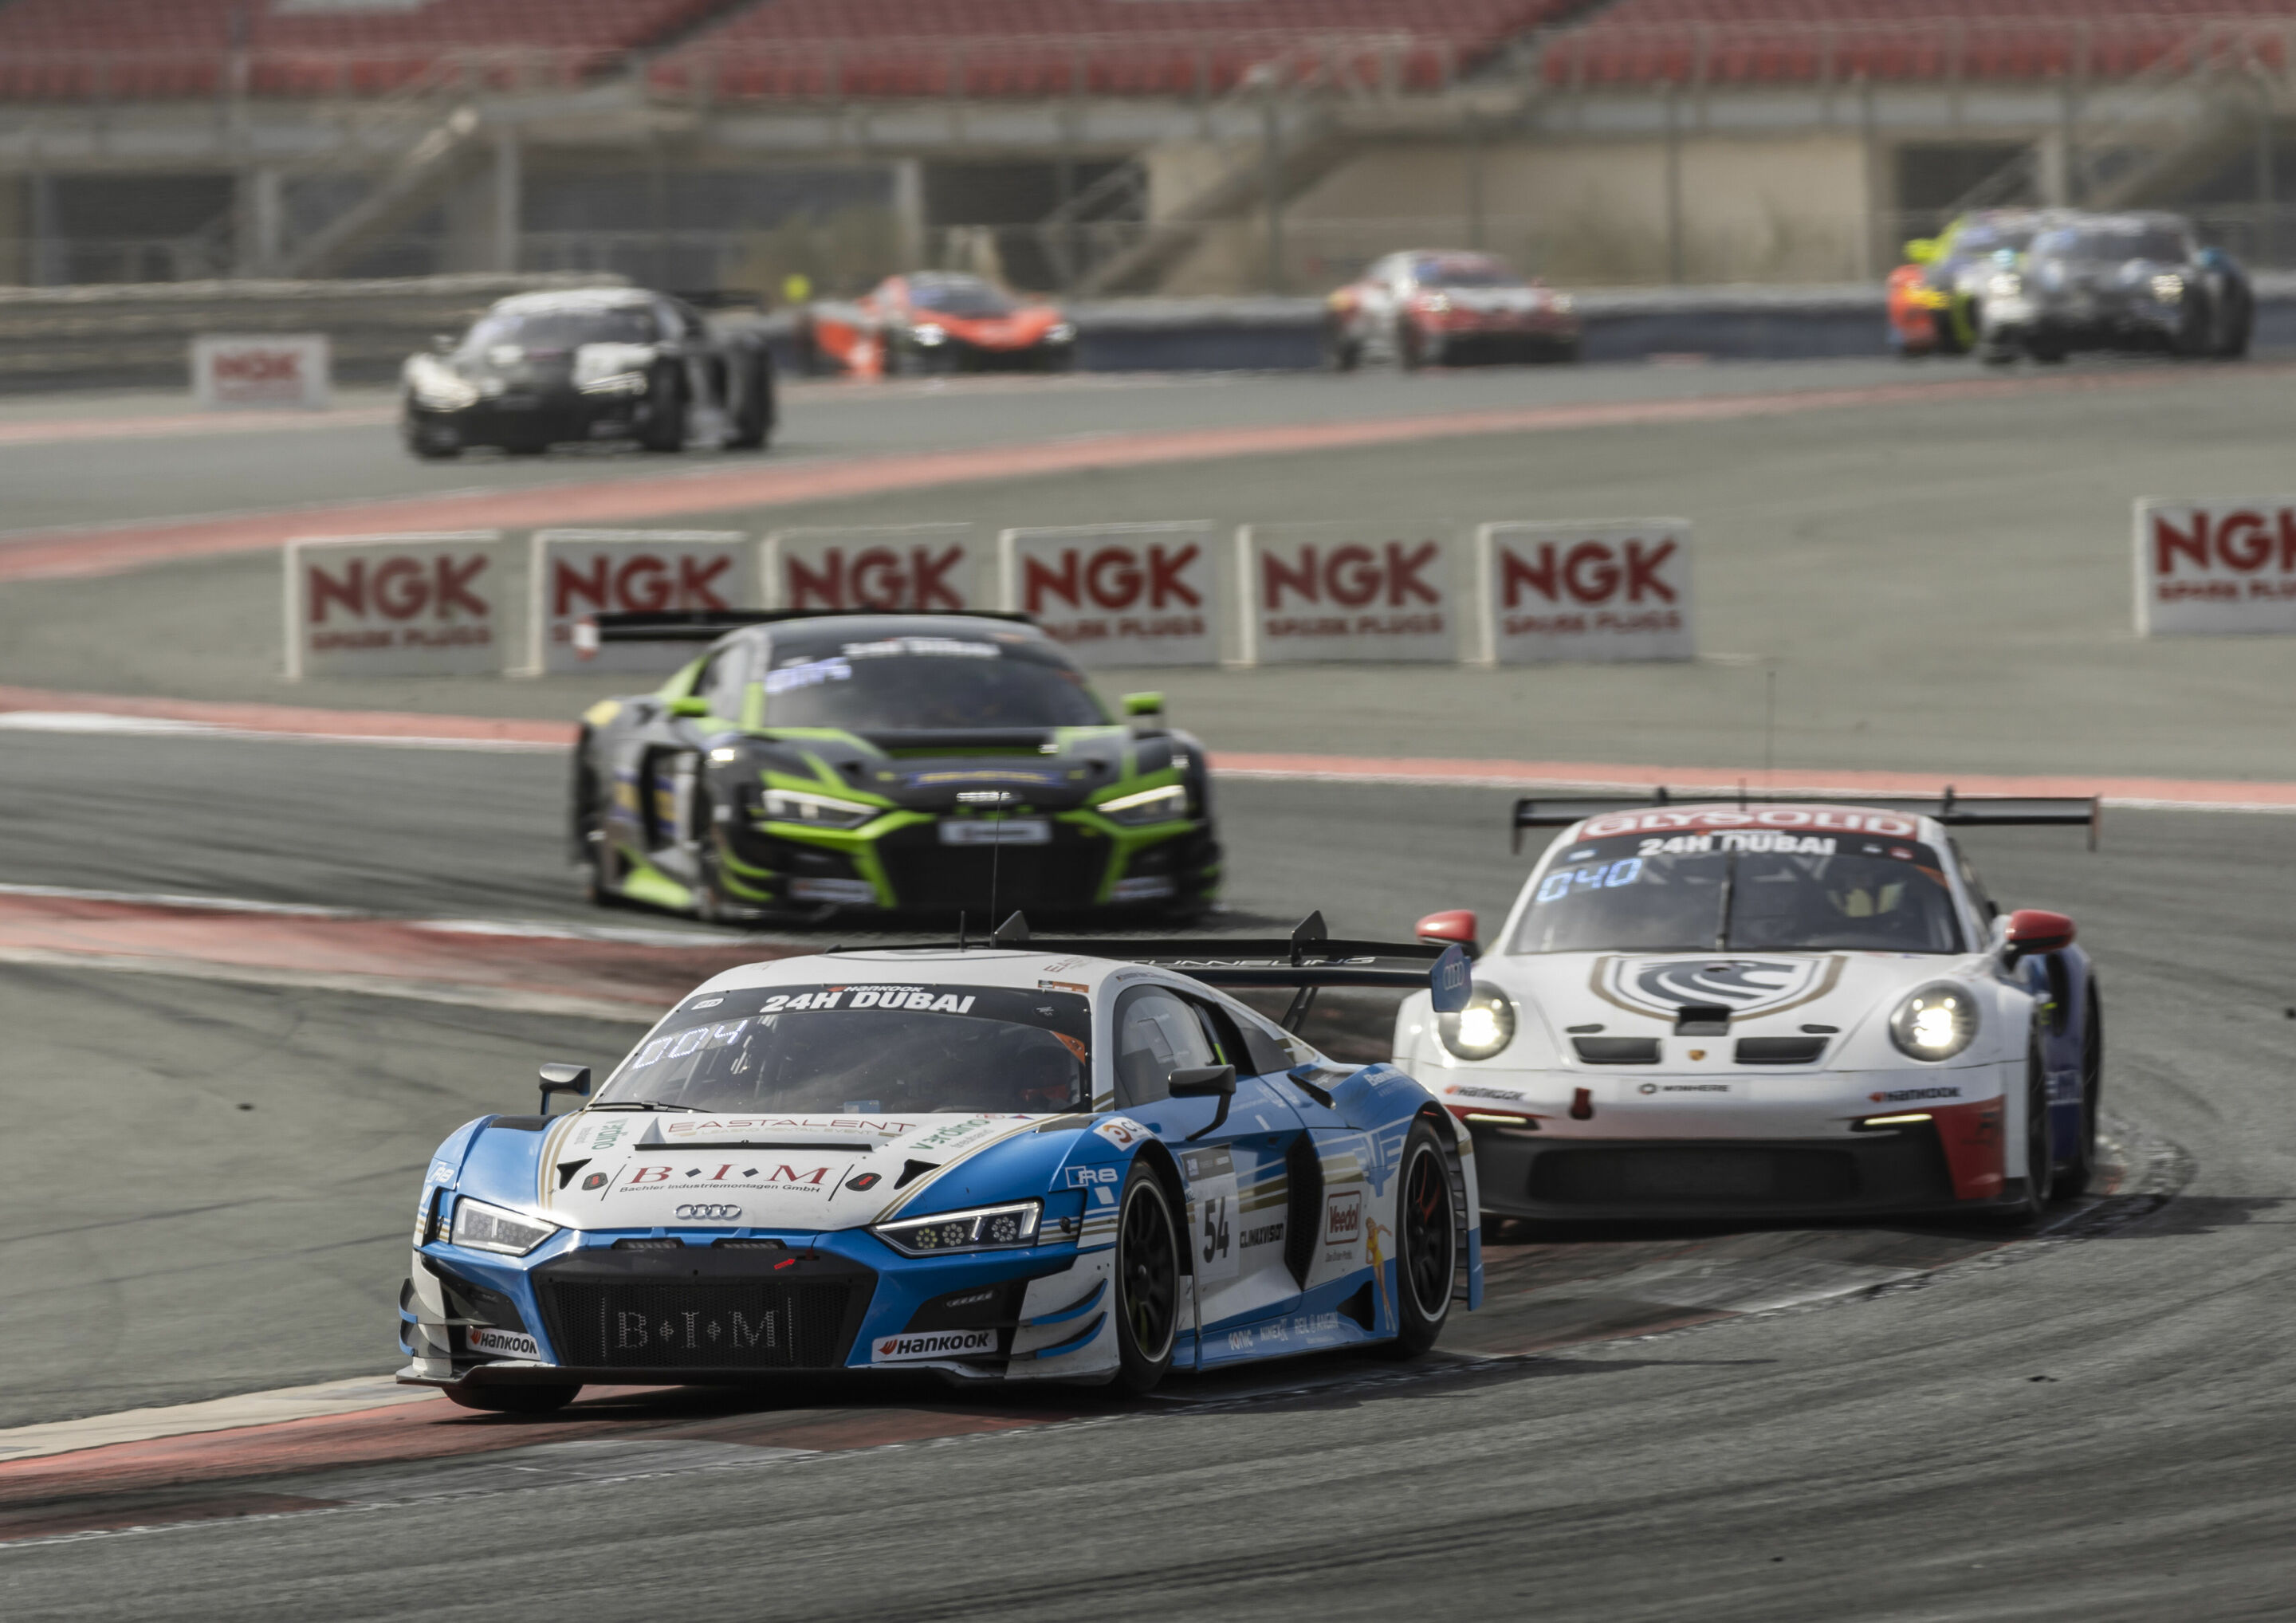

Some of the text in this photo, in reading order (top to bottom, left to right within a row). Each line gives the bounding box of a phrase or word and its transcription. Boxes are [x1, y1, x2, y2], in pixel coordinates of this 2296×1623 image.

[308, 555, 489, 623] NGK
[553, 554, 733, 615] NGK
[788, 544, 965, 611] NGK
[1024, 543, 1202, 615] NGK
[1261, 540, 1441, 611] NGK
[1500, 538, 1678, 609] NGK
[1584, 809, 1915, 838] GLYSOLID
[1637, 833, 1837, 856] 24H DUBAI
[1535, 858, 1643, 903] 040
[758, 991, 977, 1014] 24H DUBAI
[633, 1019, 748, 1070] 004
[667, 1118, 918, 1134] EASTALENT
[1077, 1168, 1119, 1185] R8
[1203, 1196, 1230, 1263] 54
[1329, 1203, 1359, 1234] Veedol
